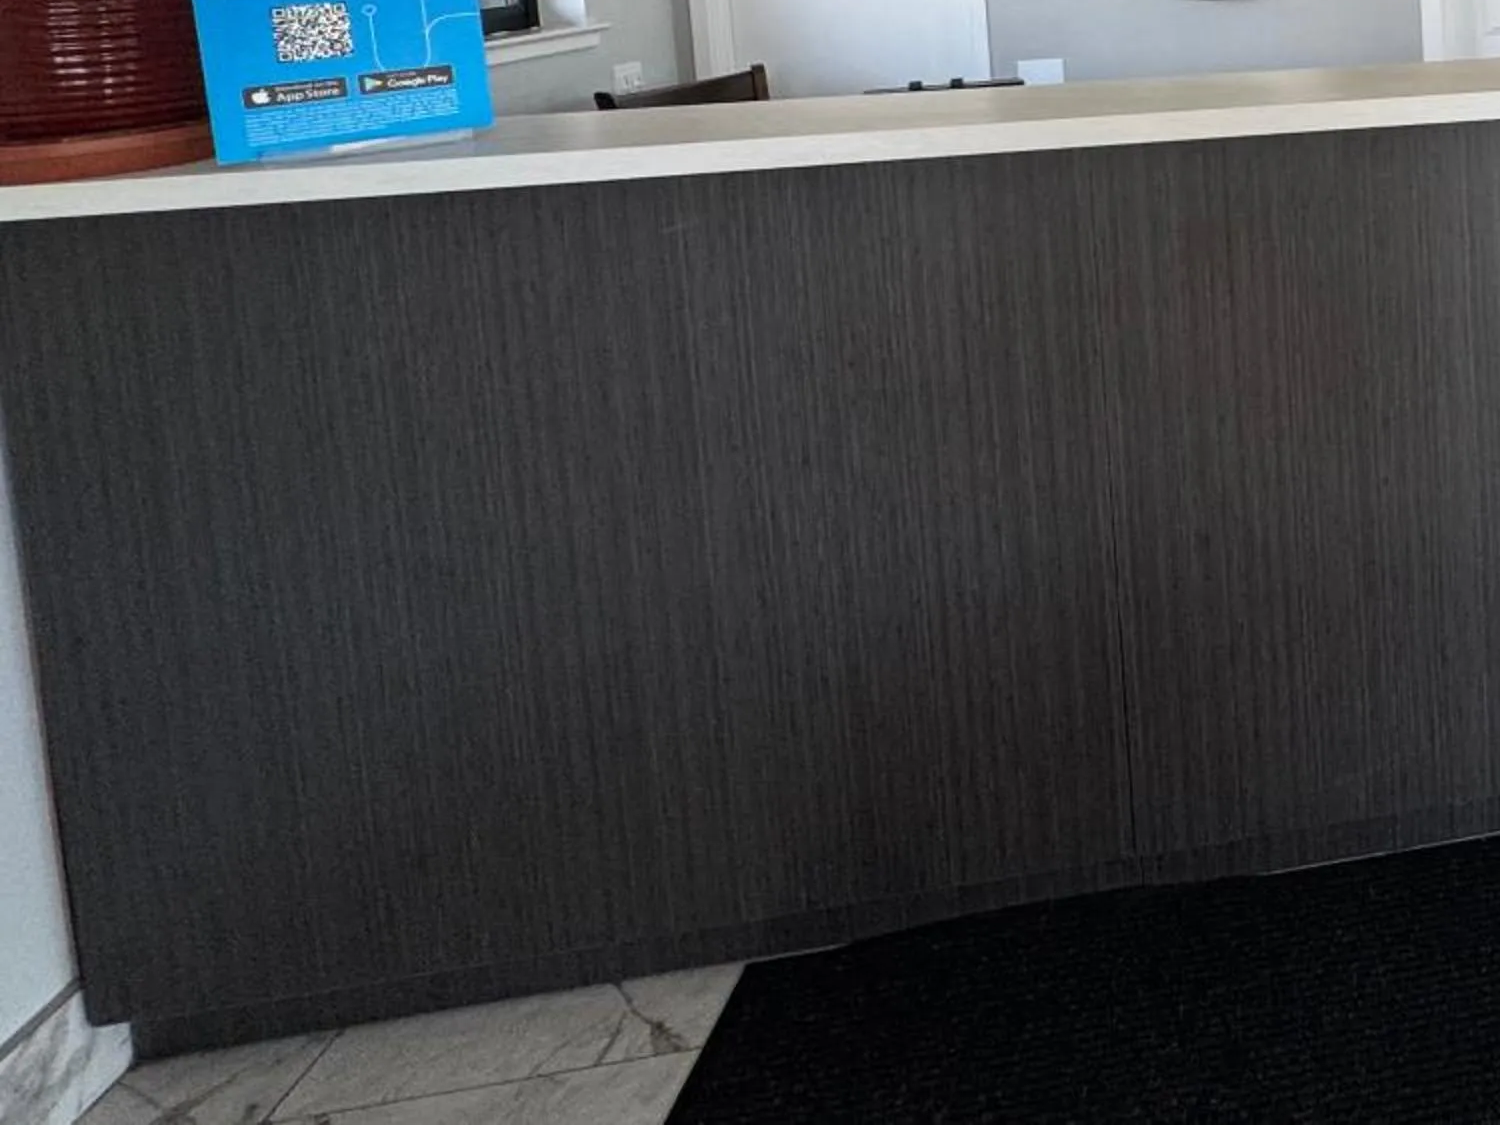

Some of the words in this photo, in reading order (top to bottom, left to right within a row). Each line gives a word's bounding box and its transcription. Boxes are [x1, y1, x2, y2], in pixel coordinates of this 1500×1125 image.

[386, 76, 426, 89] Google
[427, 73, 449, 85] Play
[275, 91, 304, 104] App
[307, 86, 340, 98] Store
